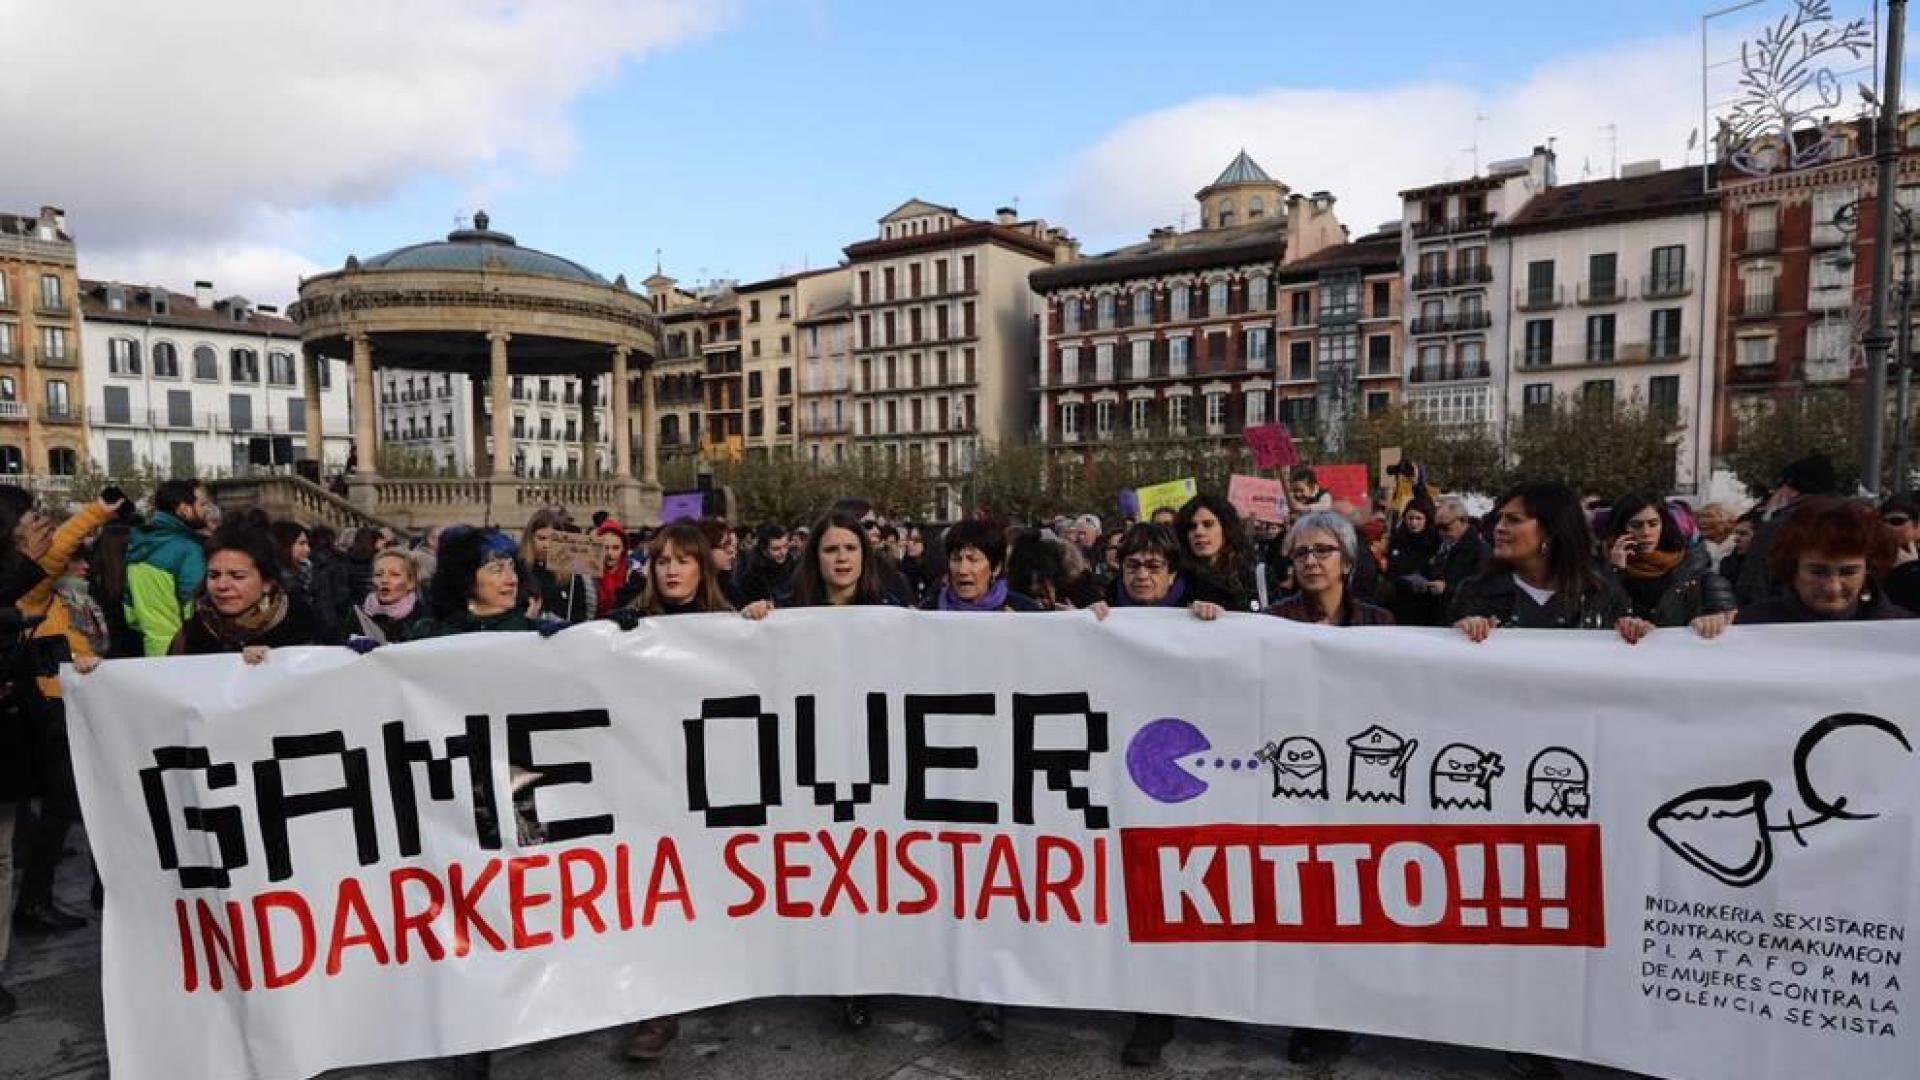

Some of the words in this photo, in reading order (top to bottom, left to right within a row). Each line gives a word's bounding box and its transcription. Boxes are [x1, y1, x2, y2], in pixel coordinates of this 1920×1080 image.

[140, 709, 614, 888] GAME
[683, 692, 1110, 828] OVER
[175, 837, 695, 992] INDARKERIA
[724, 827, 1107, 924] SEXISTARI
[1158, 841, 1569, 929] KITTO!!!
[1645, 895, 1765, 923] INDARKERIA
[1773, 912, 1905, 941] SEXISTAREN
[1643, 919, 1753, 946] KONTRAKO
[1758, 933, 1901, 965] EMAKUMEON
[1641, 984, 1773, 1019] VIOLENCIA
[1784, 1007, 1896, 1037] SEXISTA
[1642, 961, 1668, 978] DE
[1672, 966, 1762, 991] MUJERES
[1769, 980, 1862, 1010] CONTRA
[1870, 999, 1899, 1014] LA
